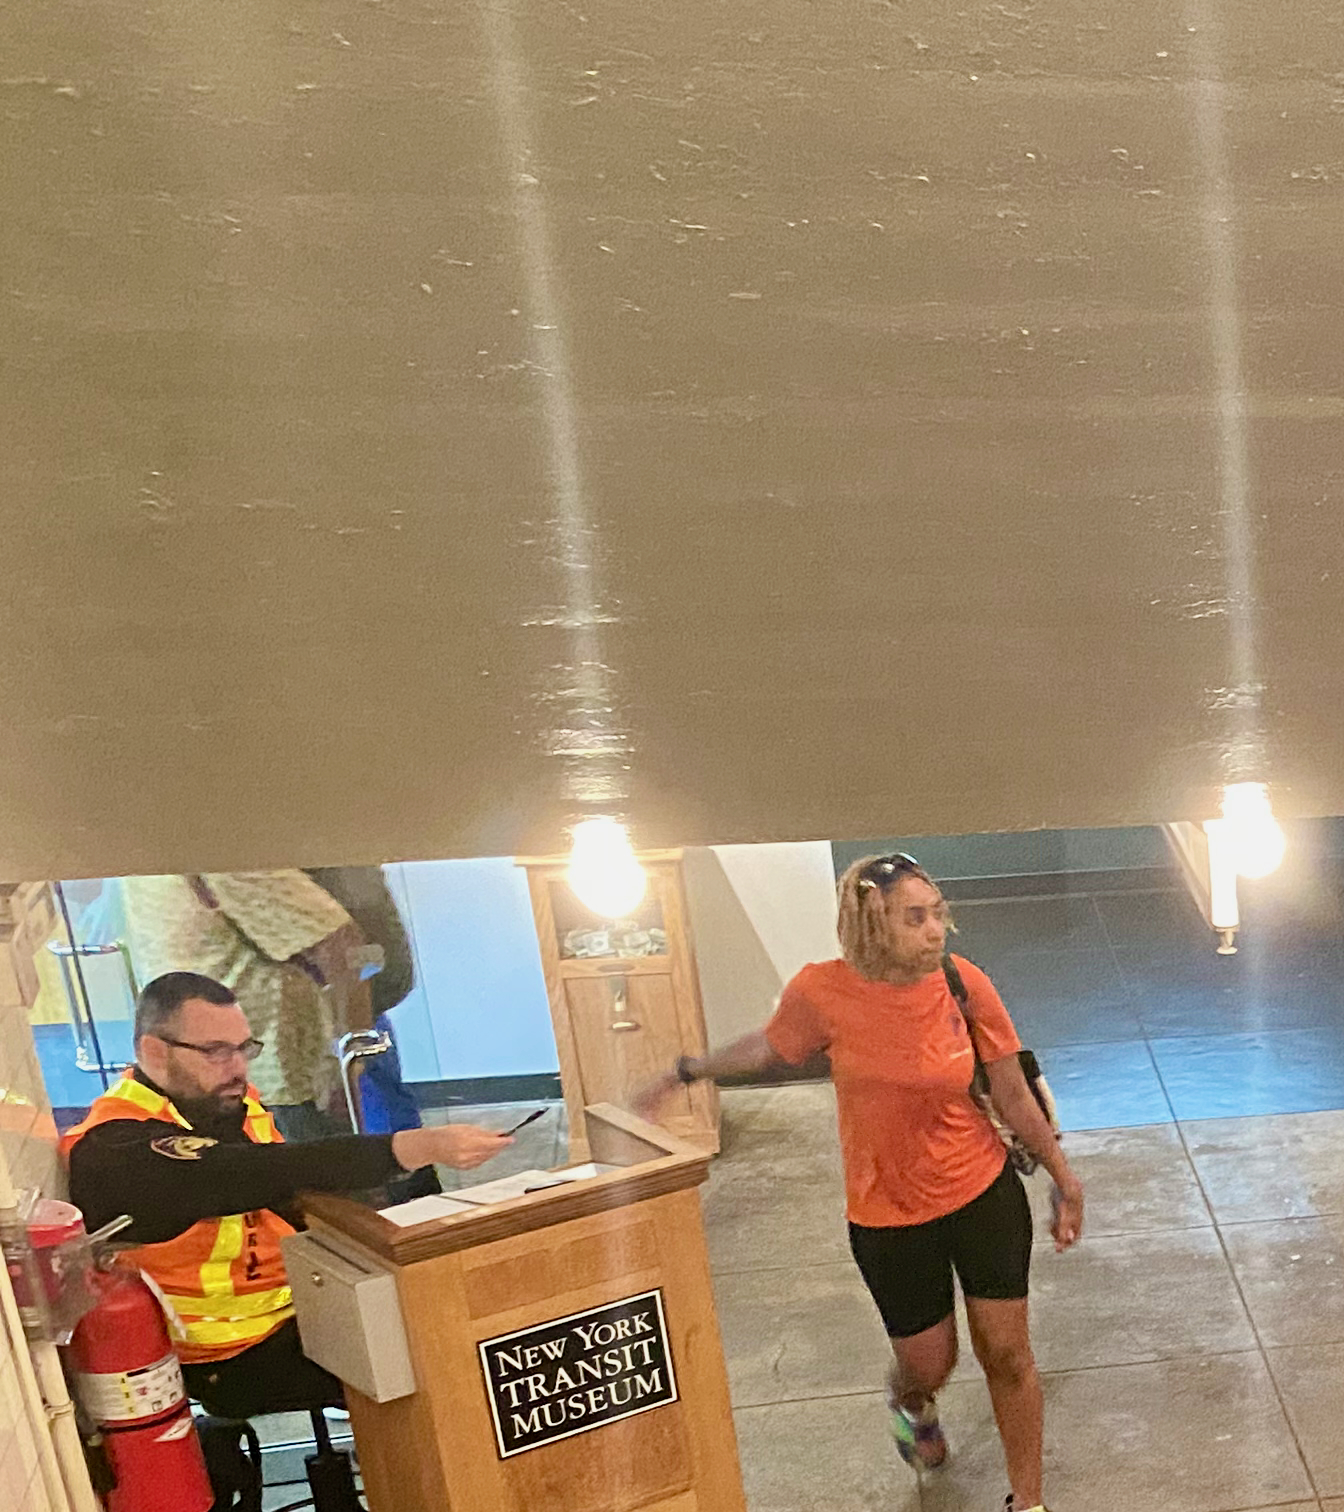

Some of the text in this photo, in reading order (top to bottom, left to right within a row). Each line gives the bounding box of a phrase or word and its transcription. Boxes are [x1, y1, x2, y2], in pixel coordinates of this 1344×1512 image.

[494, 1311, 654, 1378] NEW YORK
[500, 1336, 657, 1409] TRANSIT
[510, 1367, 664, 1439] MUSEUM
